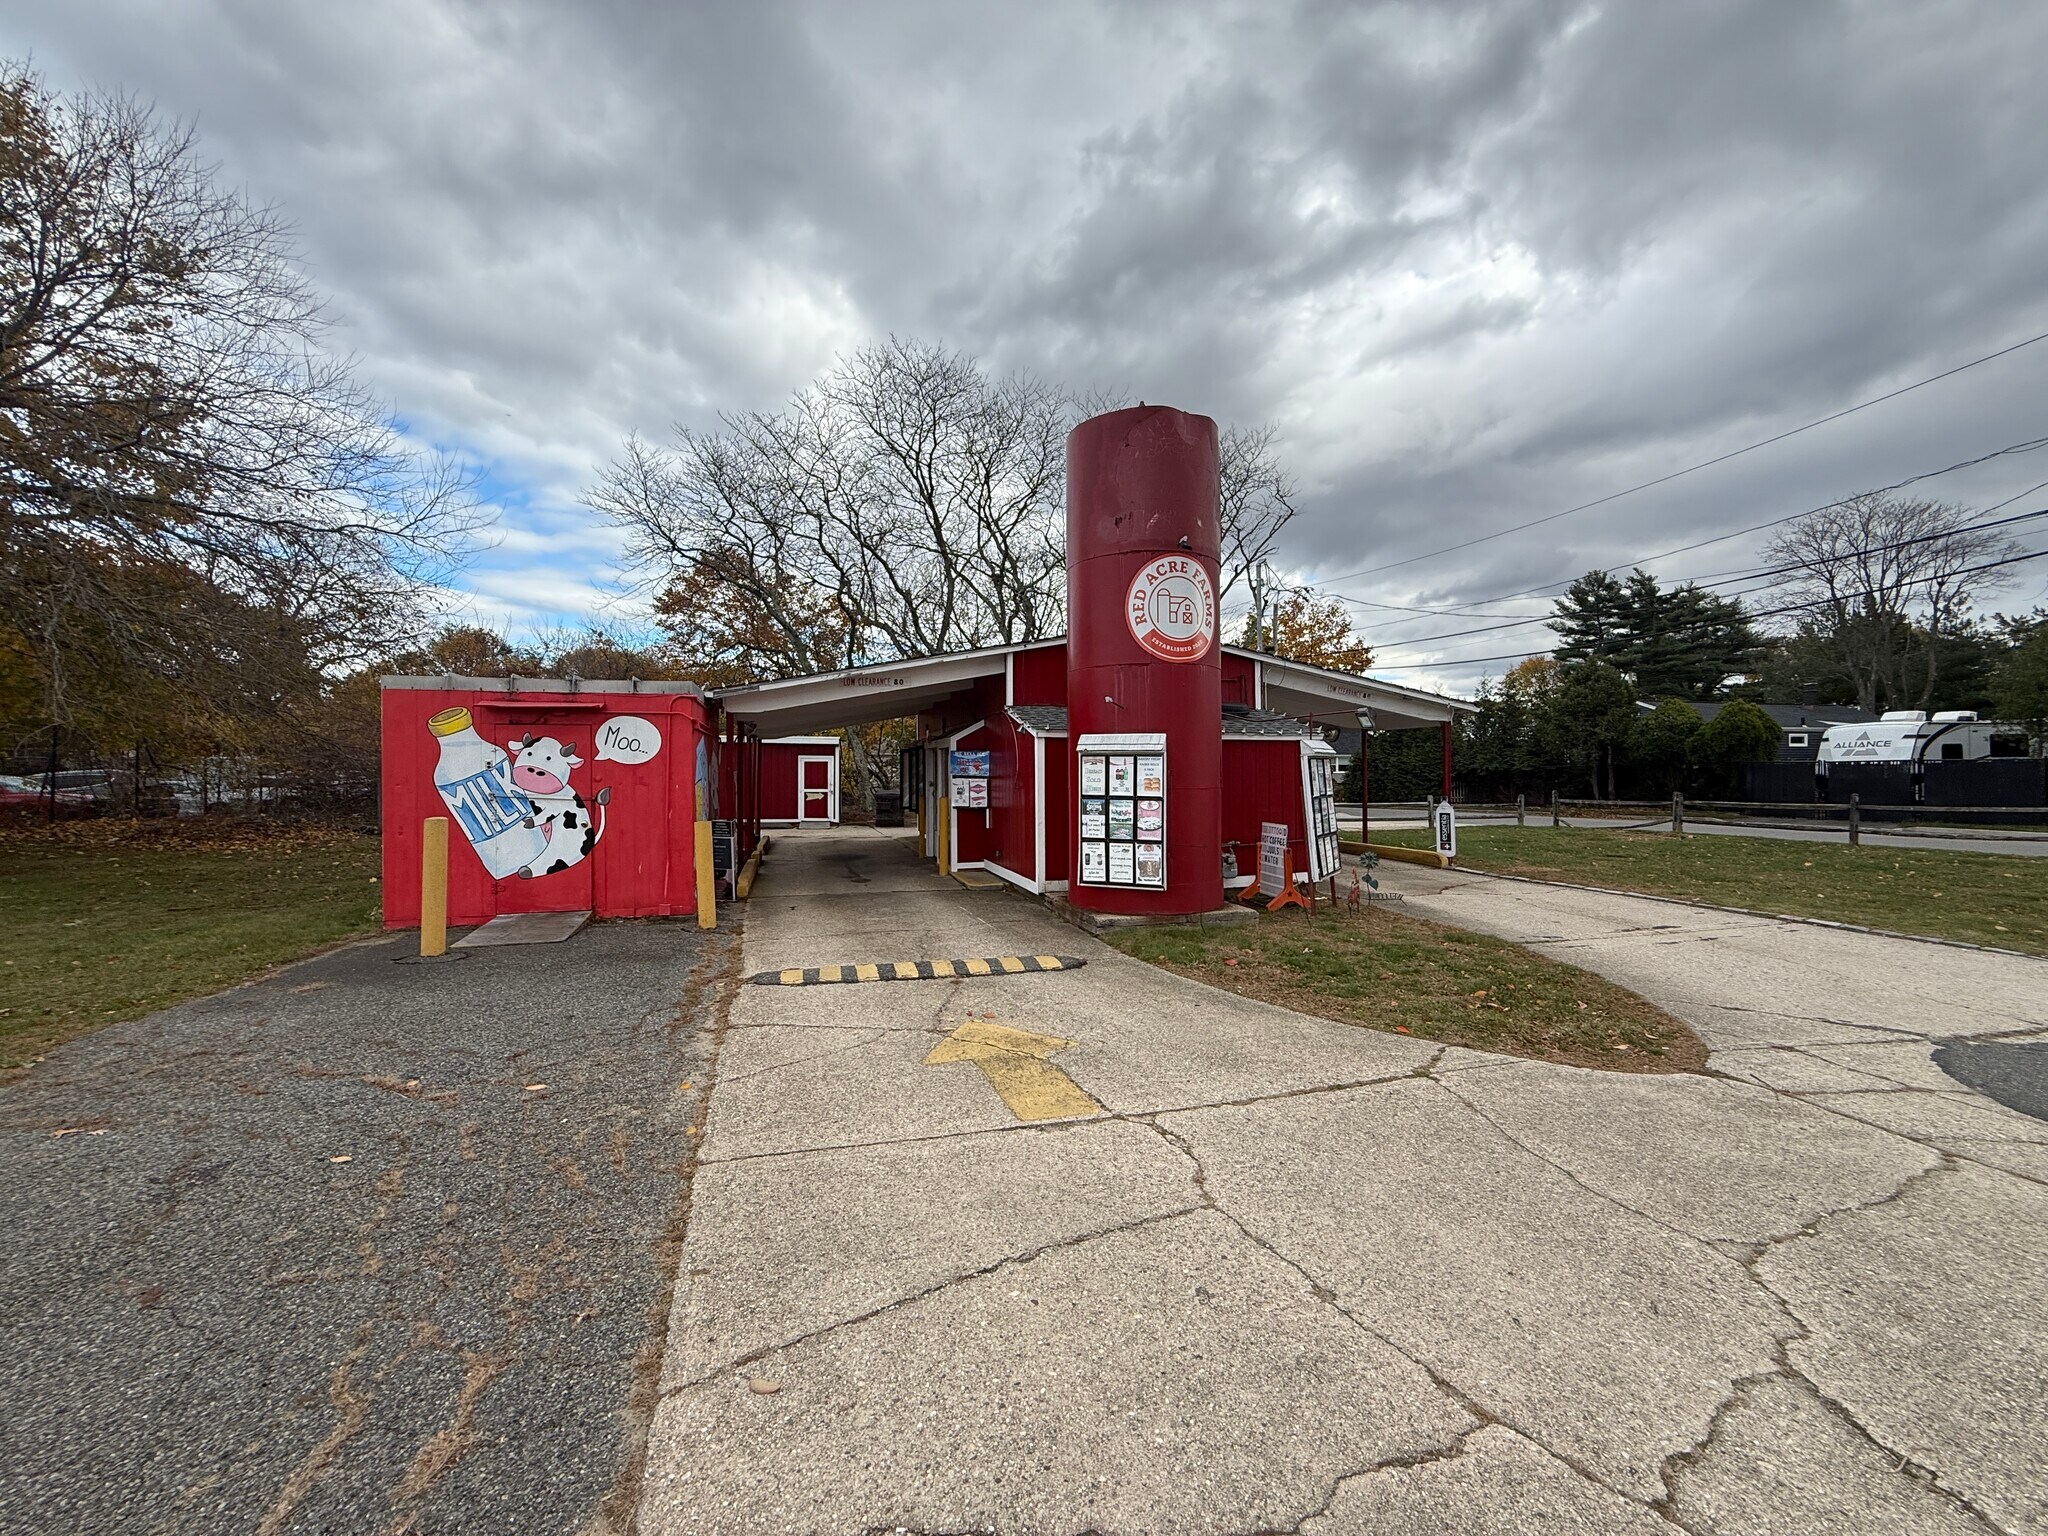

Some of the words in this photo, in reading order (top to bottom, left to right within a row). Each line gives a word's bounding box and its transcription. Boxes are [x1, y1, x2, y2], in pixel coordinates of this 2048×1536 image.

[1132, 588, 1148, 626] RED
[1145, 560, 1189, 586] ACRE
[1191, 567, 1213, 630] FARMS
[1151, 637, 1192, 652] ESTABLISHED
[843, 677, 856, 687] LOW
[857, 677, 891, 687] CLEARANCE
[604, 725, 648, 754] Moo...
[1833, 740, 1893, 749] ALLIANCE
[439, 758, 529, 841] MILK
[1264, 855, 1279, 865] WATER
